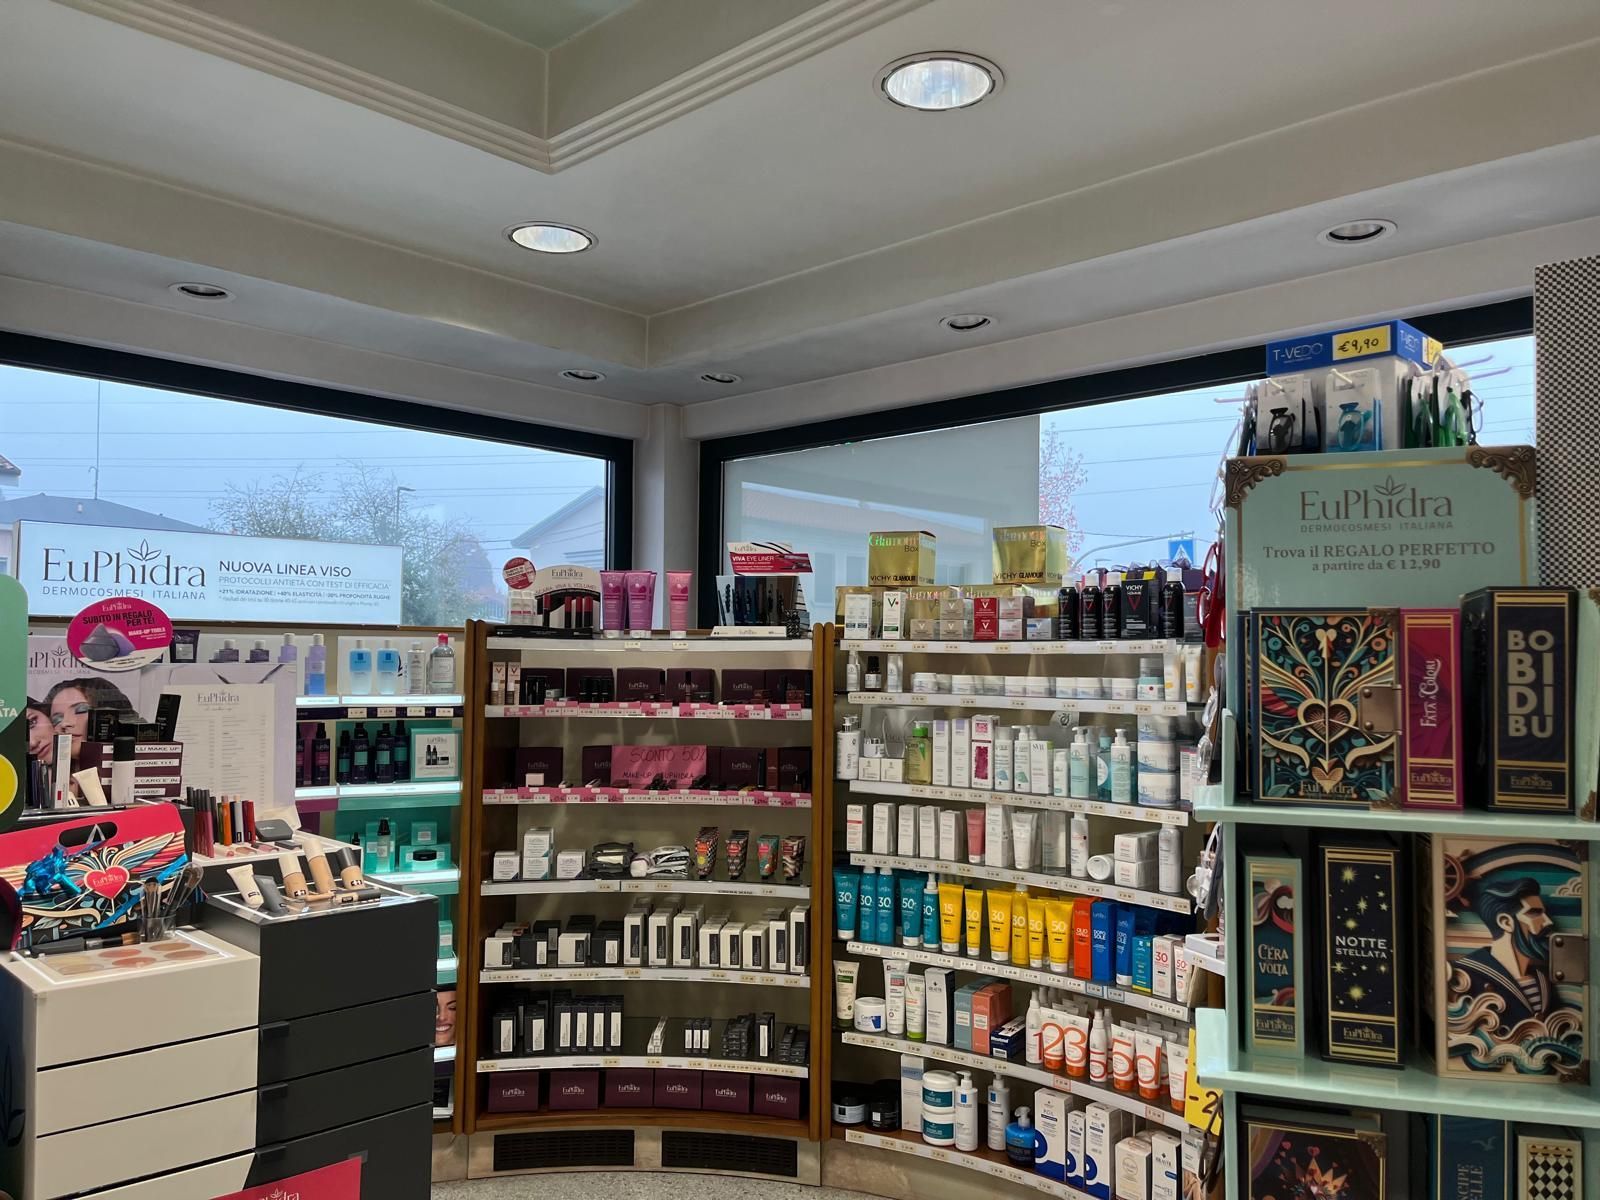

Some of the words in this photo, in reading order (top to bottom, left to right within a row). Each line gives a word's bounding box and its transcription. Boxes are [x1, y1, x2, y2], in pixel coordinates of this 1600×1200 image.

[1301, 487, 1453, 521] EuPhidra
[1301, 523, 1391, 533] DERMOCOSMESI
[1400, 521, 1454, 531] ITALIANA
[1263, 546, 1306, 558] Trova
[1310, 545, 1319, 557] il
[1324, 544, 1394, 557] REGALO
[1399, 541, 1496, 556] PERFETTO
[42, 548, 206, 588] EuPhidra
[219, 560, 273, 574] NUOVA
[277, 563, 318, 576] LINEA
[320, 566, 352, 578] VISO
[1312, 563, 1319, 571] a
[1322, 559, 1365, 574] partire
[1368, 559, 1384, 570] da
[1387, 560, 1397, 570] €
[1401, 558, 1441, 571] 12,90
[994, 572, 1017, 580] VICHY
[1019, 571, 1044, 579] GLAMOUR
[307, 580, 325, 588] CON
[327, 581, 343, 589] TEST
[42, 586, 144, 598] DERMOCOSMESI
[152, 590, 206, 600] ITALIANA
[83, 614, 112, 625] SUBITO
[113, 613, 121, 622] IN
[122, 610, 153, 621] REGALO
[126, 618, 142, 627] PER
[143, 618, 155, 626] TE!
[1507, 630, 1554, 651] BO
[1507, 652, 1554, 685] BI
[1508, 686, 1554, 716] DI
[1508, 715, 1551, 738] BU
[630, 747, 675, 762] SCONTO
[682, 746, 706, 761] 50%
[838, 891, 852, 903] 30
[878, 897, 891, 907] 30
[944, 903, 953, 914] 15
[992, 911, 1005, 921] 30
[1335, 936, 1387, 950] NOTTE
[1155, 951, 1168, 963] 30
[1335, 948, 1387, 960] STELLATA
[1258, 962, 1289, 977] VOLTA
